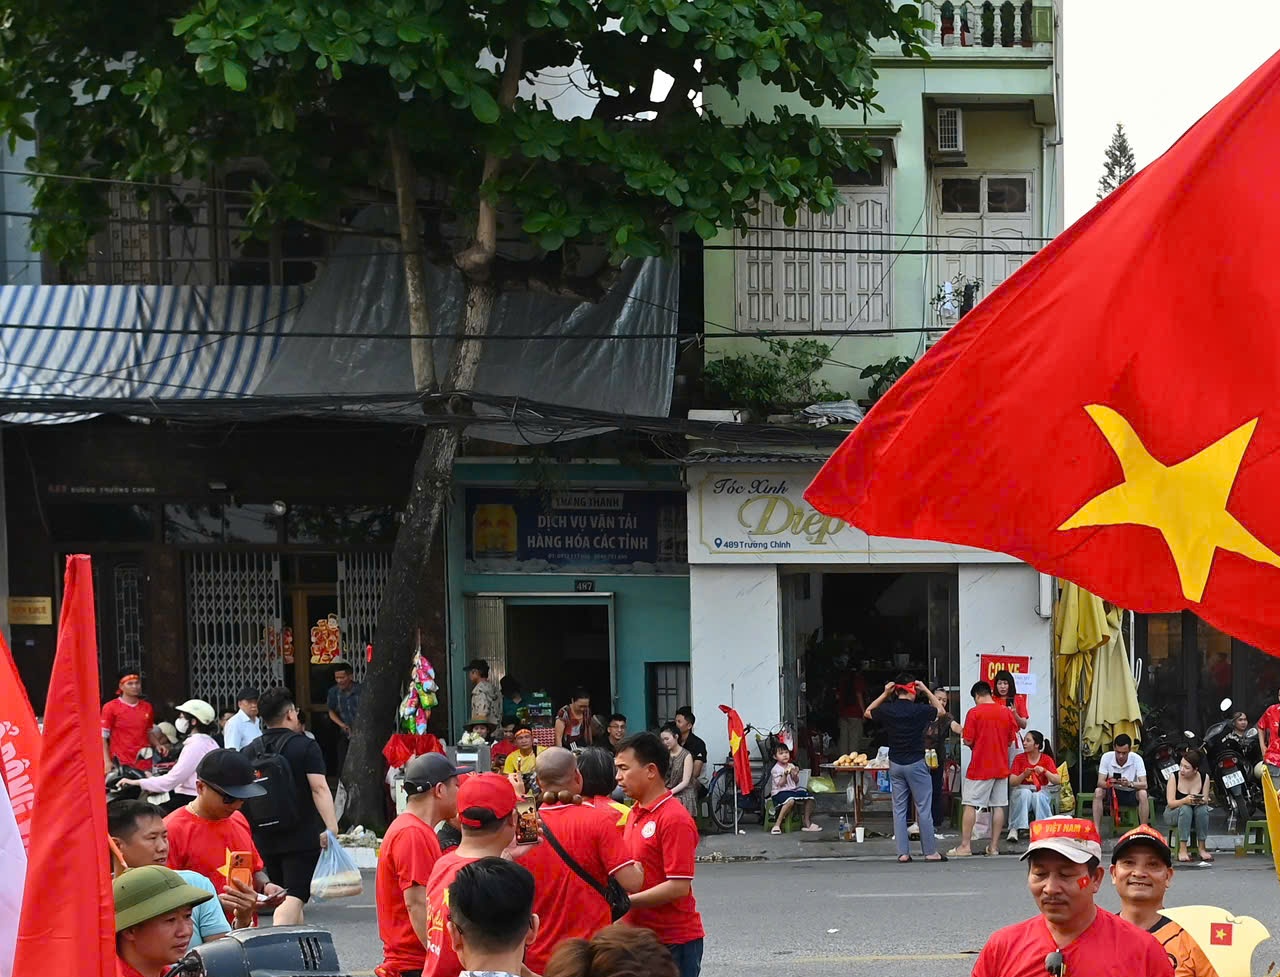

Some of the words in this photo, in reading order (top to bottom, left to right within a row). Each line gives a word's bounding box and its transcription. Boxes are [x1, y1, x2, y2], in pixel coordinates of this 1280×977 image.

[713, 478, 745, 495] Tóc
[748, 479, 789, 495] Xinh
[537, 515, 568, 532] DỊCH
[571, 515, 587, 532] VỤ
[589, 513, 615, 532] VẬN
[618, 513, 638, 529] TẢI
[527, 533, 561, 549] HÀNG
[565, 533, 590, 549] HÓA
[593, 533, 616, 549] CÁC
[618, 532, 649, 549] TỈNH
[723, 541, 739, 549] 489
[739, 540, 768, 550] Trường
[770, 540, 791, 549] Chinh
[576, 582, 593, 591] 487
[1045, 822, 1062, 834] VIỆT
[1064, 823, 1082, 833] NAM
